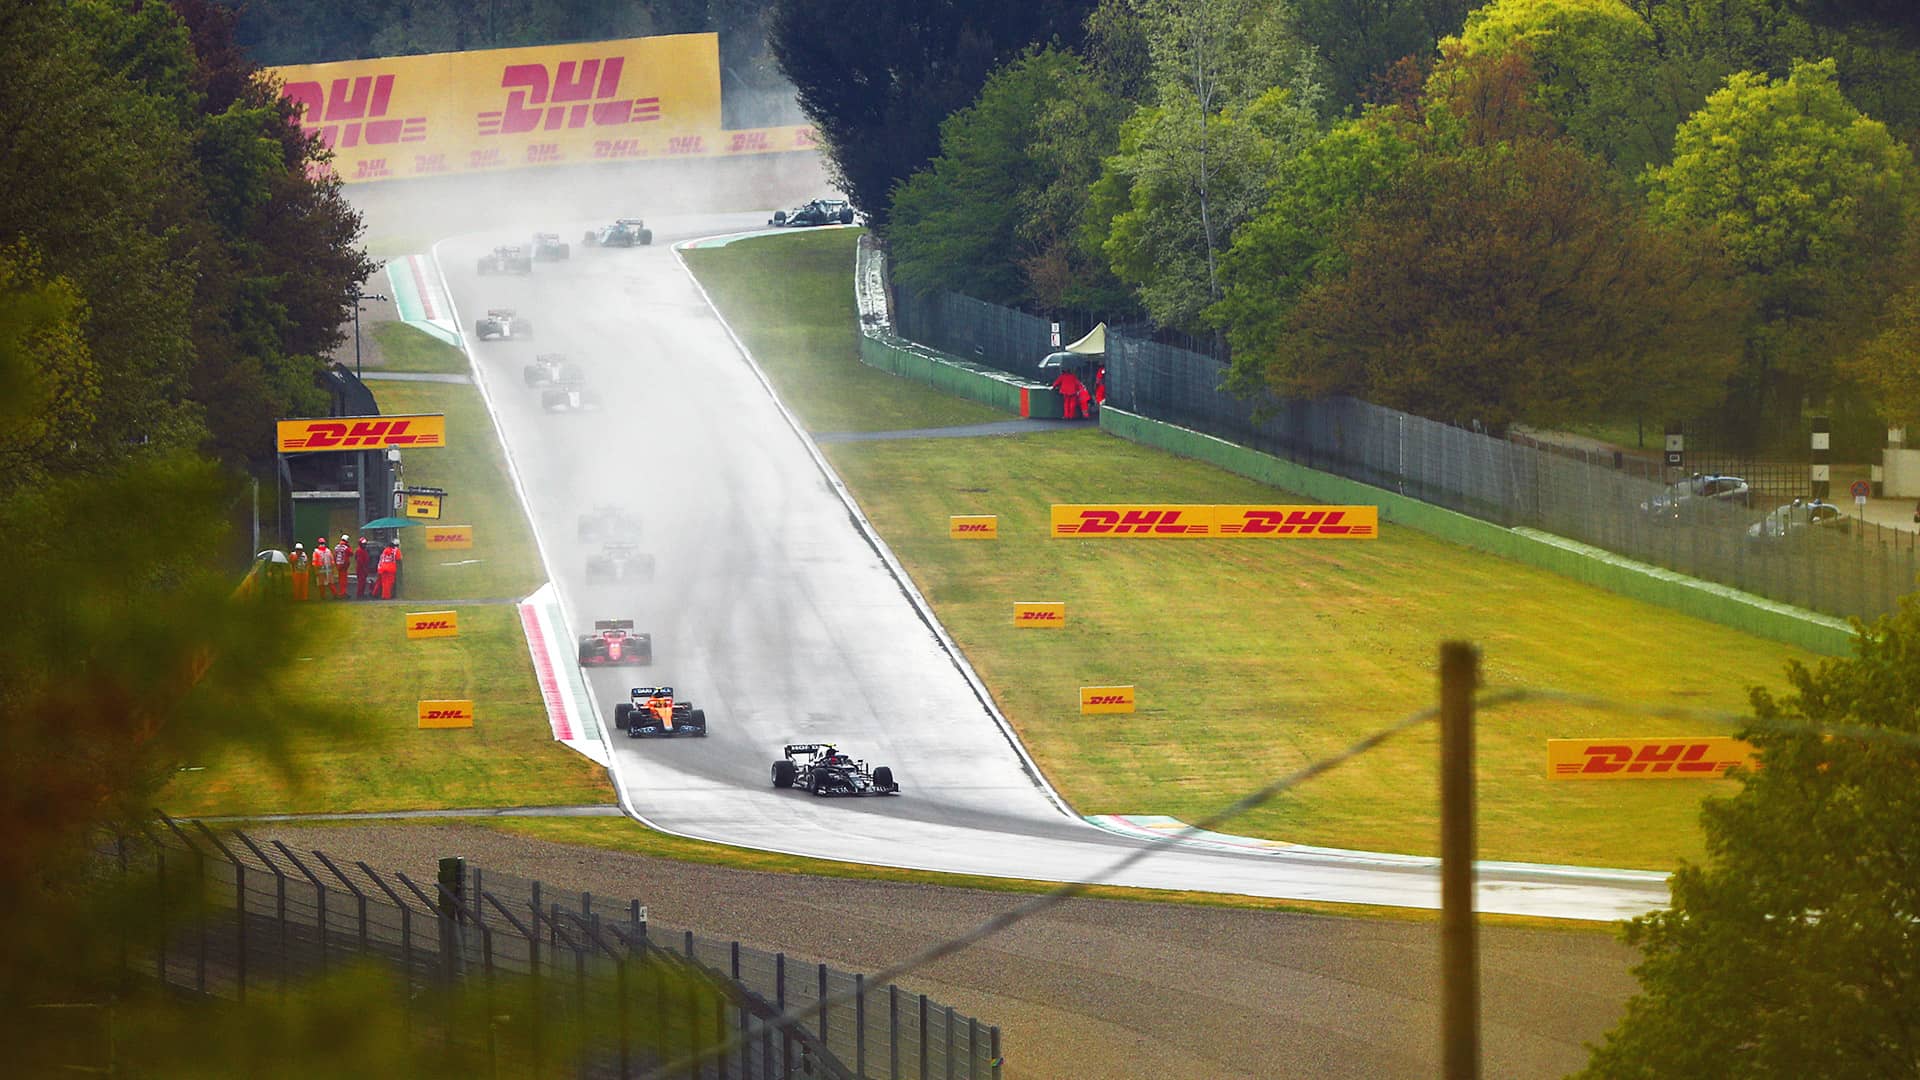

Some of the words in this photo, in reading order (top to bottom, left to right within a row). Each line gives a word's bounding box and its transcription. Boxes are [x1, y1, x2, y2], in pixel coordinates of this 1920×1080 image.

[501, 56, 634, 134] DHL
[592, 139, 640, 159] DHL
[730, 132, 768, 151] DHL
[354, 159, 391, 179] DHL
[305, 421, 417, 447] DHL
[958, 524, 988, 532] DHL
[1078, 510, 1189, 534] DHL
[1241, 511, 1352, 535] DHL
[433, 534, 464, 542] DHL
[1023, 611, 1055, 620] DHL
[415, 621, 448, 630] DHL
[1090, 695, 1125, 704] DHL
[428, 710, 463, 719] DHL
[1583, 744, 1716, 773] DHL
